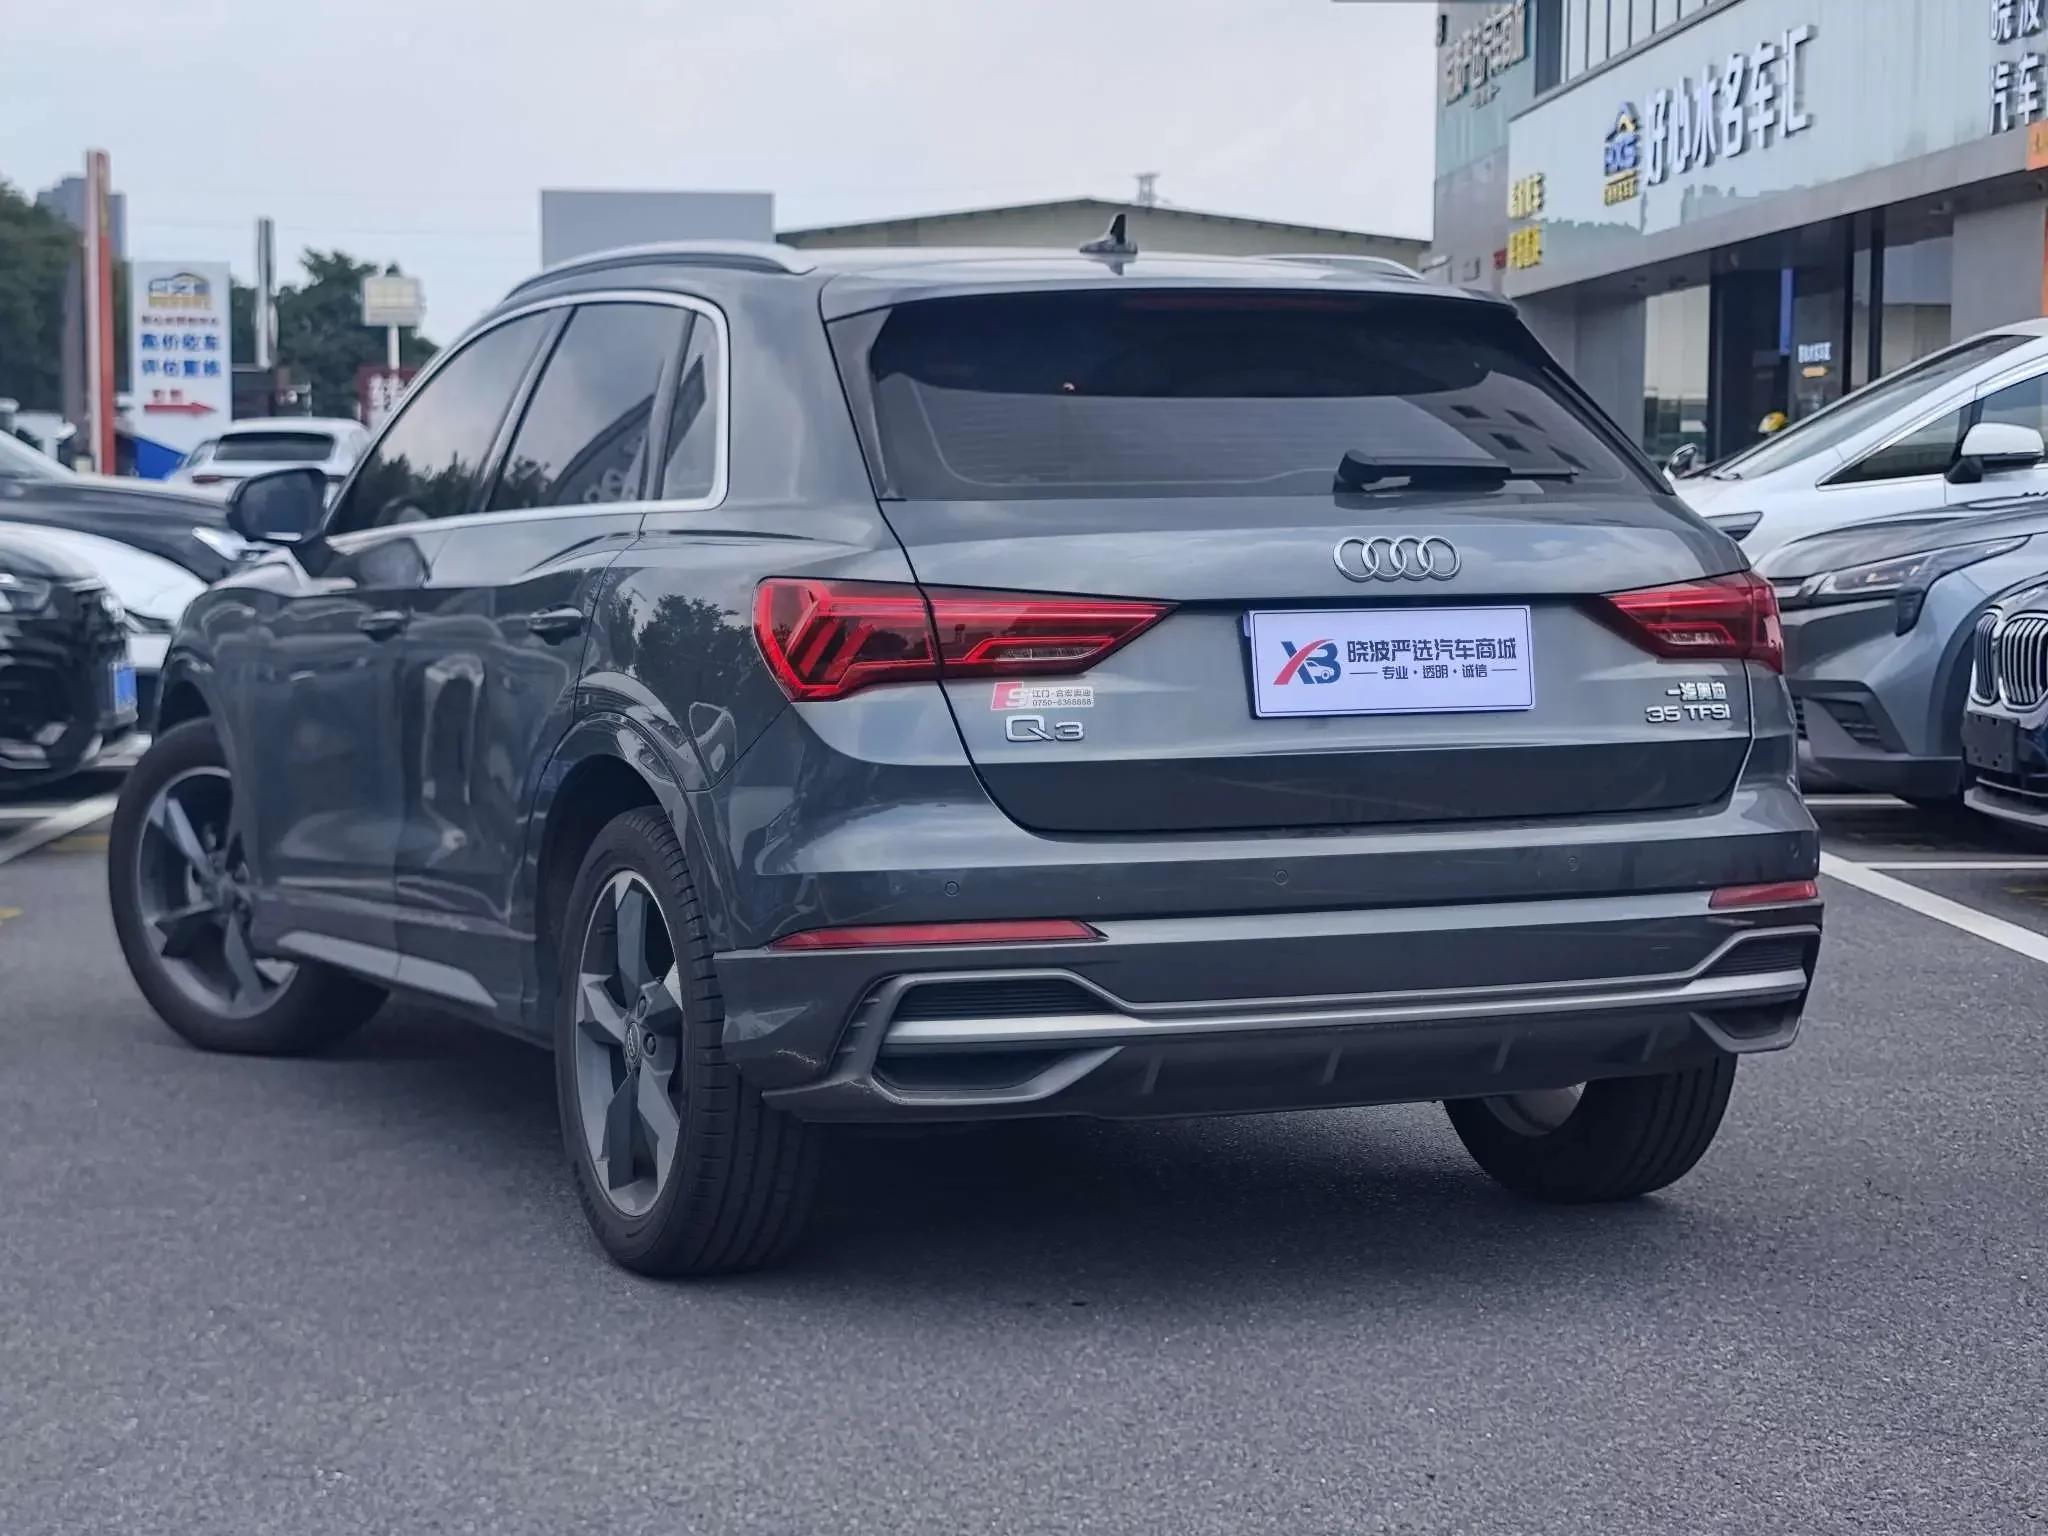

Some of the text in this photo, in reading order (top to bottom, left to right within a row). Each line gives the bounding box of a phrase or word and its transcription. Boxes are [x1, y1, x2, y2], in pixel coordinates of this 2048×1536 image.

[1643, 24, 1812, 186] 好心水名车汇
[1989, 53, 2040, 135] 汽车
[1347, 637, 1517, 663] 晓波严选汽车商城
[1646, 703, 1731, 723] 35 TFSI
[1005, 714, 1085, 742] Q3
